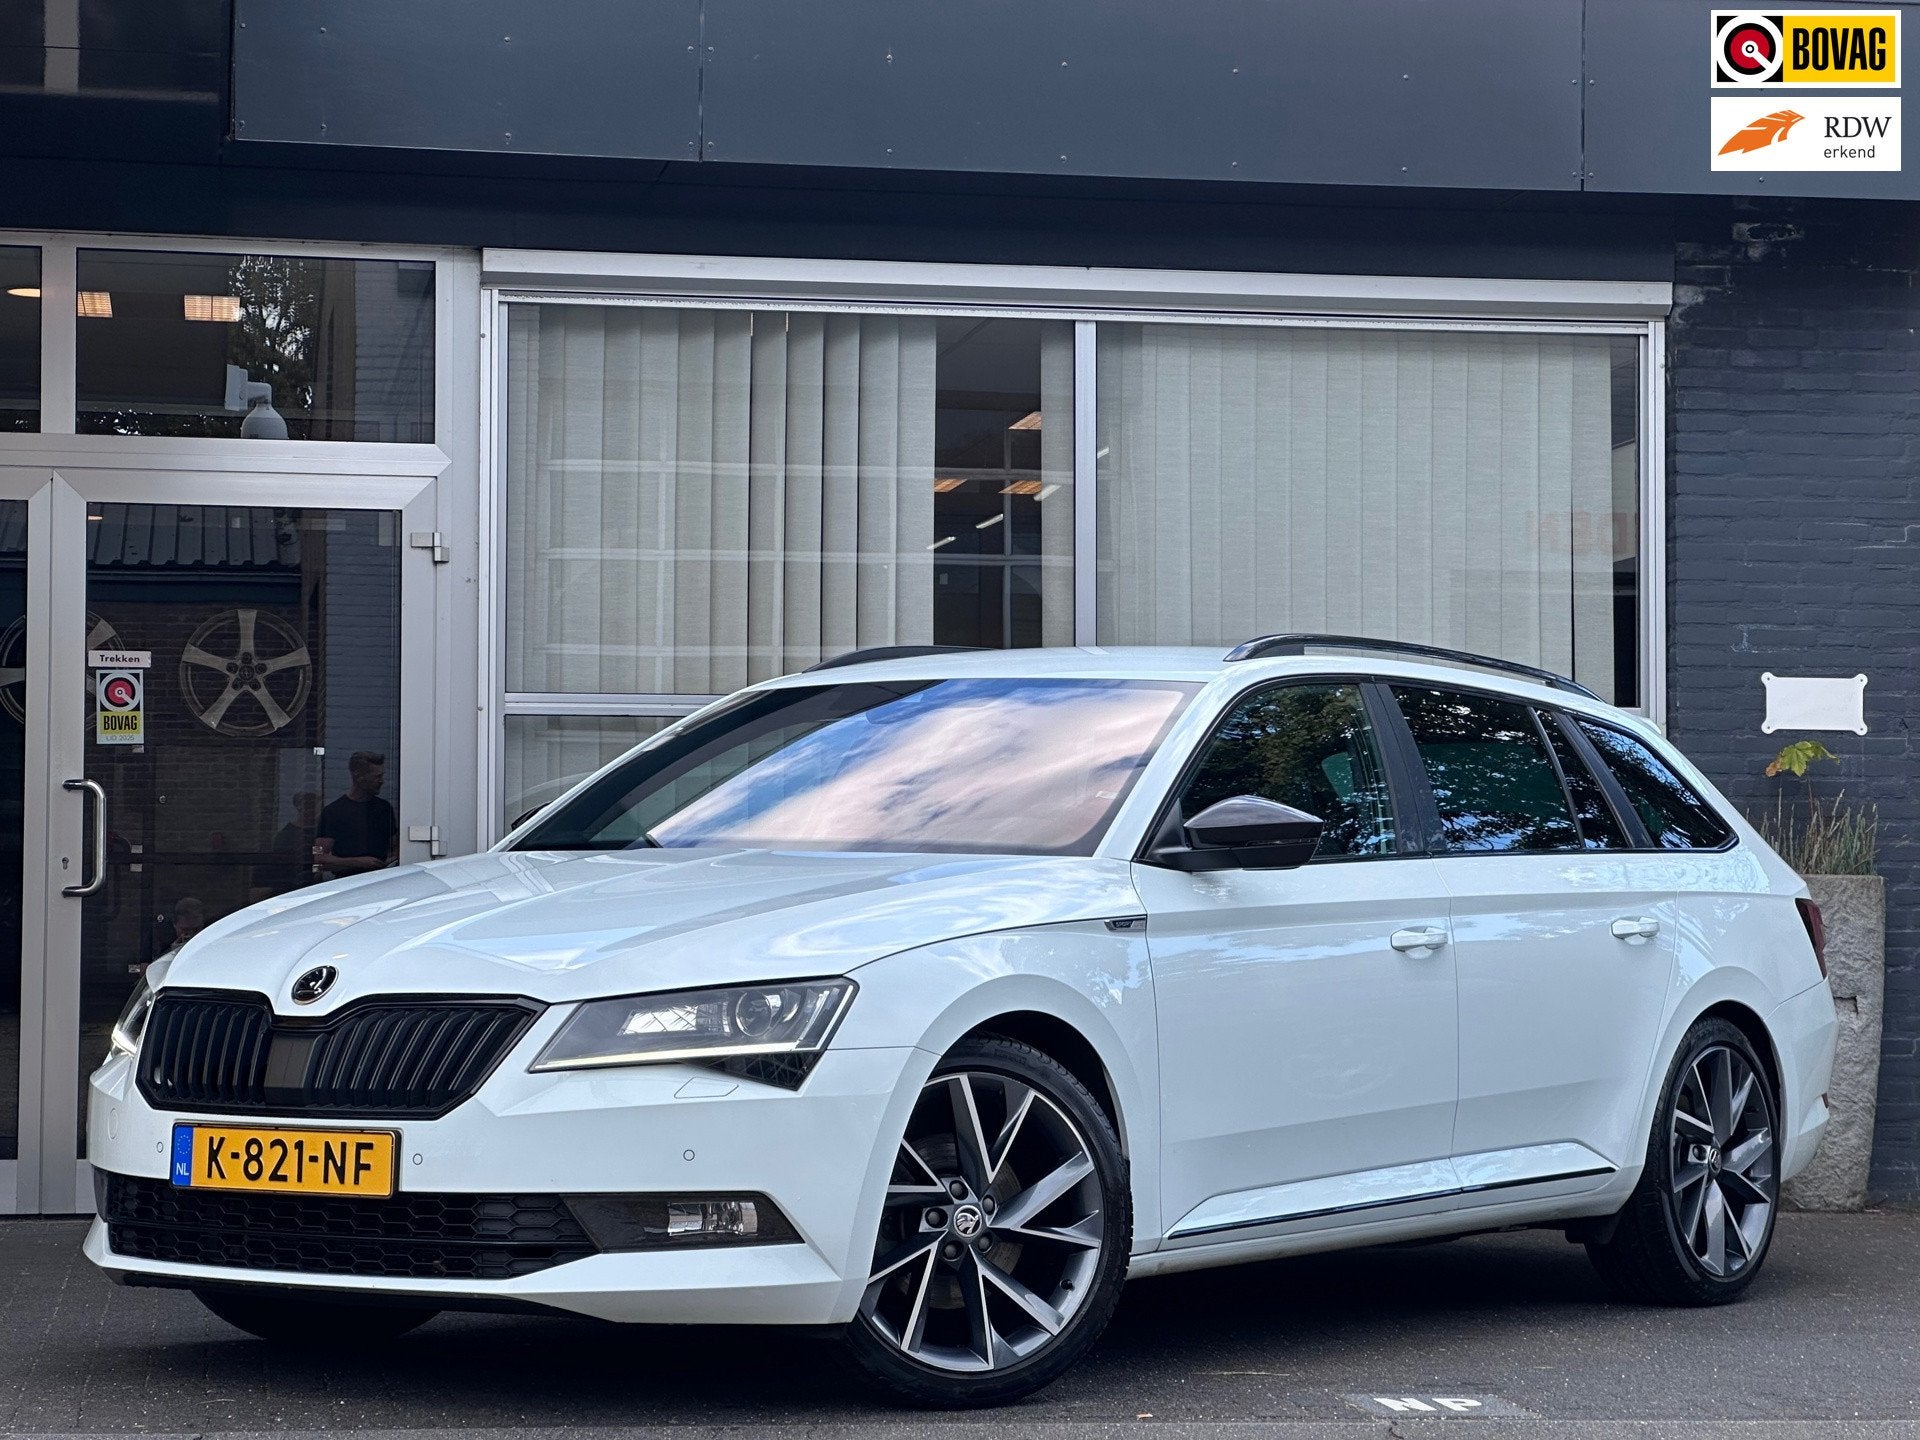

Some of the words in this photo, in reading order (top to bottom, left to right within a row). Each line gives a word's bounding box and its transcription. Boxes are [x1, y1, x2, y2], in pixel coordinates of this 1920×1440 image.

[99, 654, 140, 663] Trekken
[103, 715, 138, 731] BOVAG
[207, 1135, 374, 1186] K-821-NF
[176, 1162, 190, 1176] NL
[1373, 1397, 1482, 1412] NP
